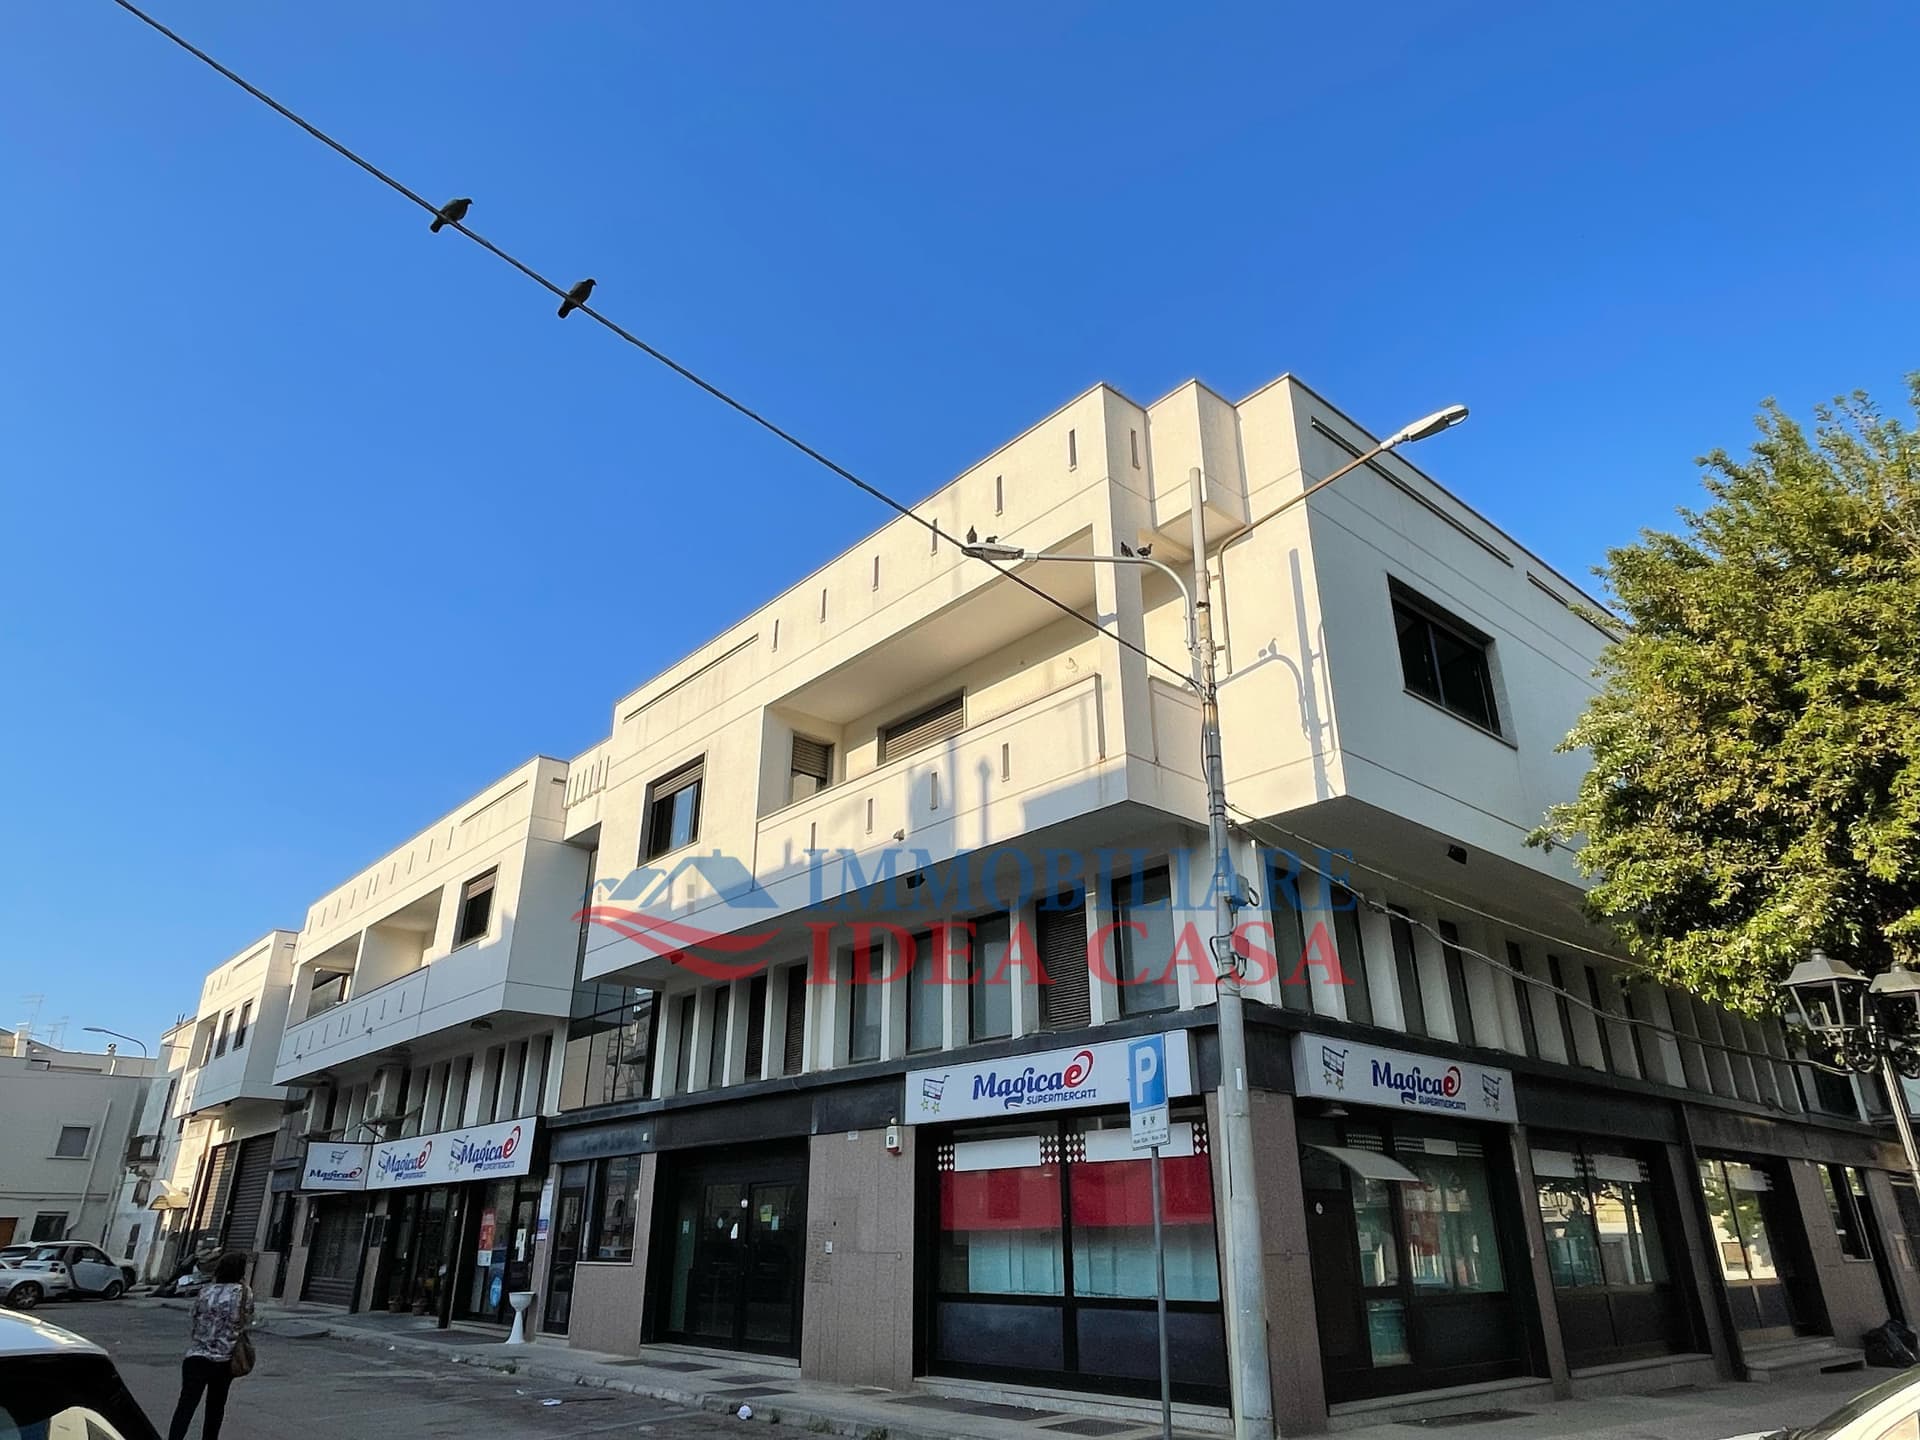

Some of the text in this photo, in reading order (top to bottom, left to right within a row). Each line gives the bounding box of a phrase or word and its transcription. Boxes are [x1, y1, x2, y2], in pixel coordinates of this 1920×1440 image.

[973, 1050, 1093, 1109] Magicae
[1026, 1088, 1097, 1105] SUPERMERCATI
[1135, 1045, 1157, 1103] P
[1371, 1059, 1461, 1104] Magicae
